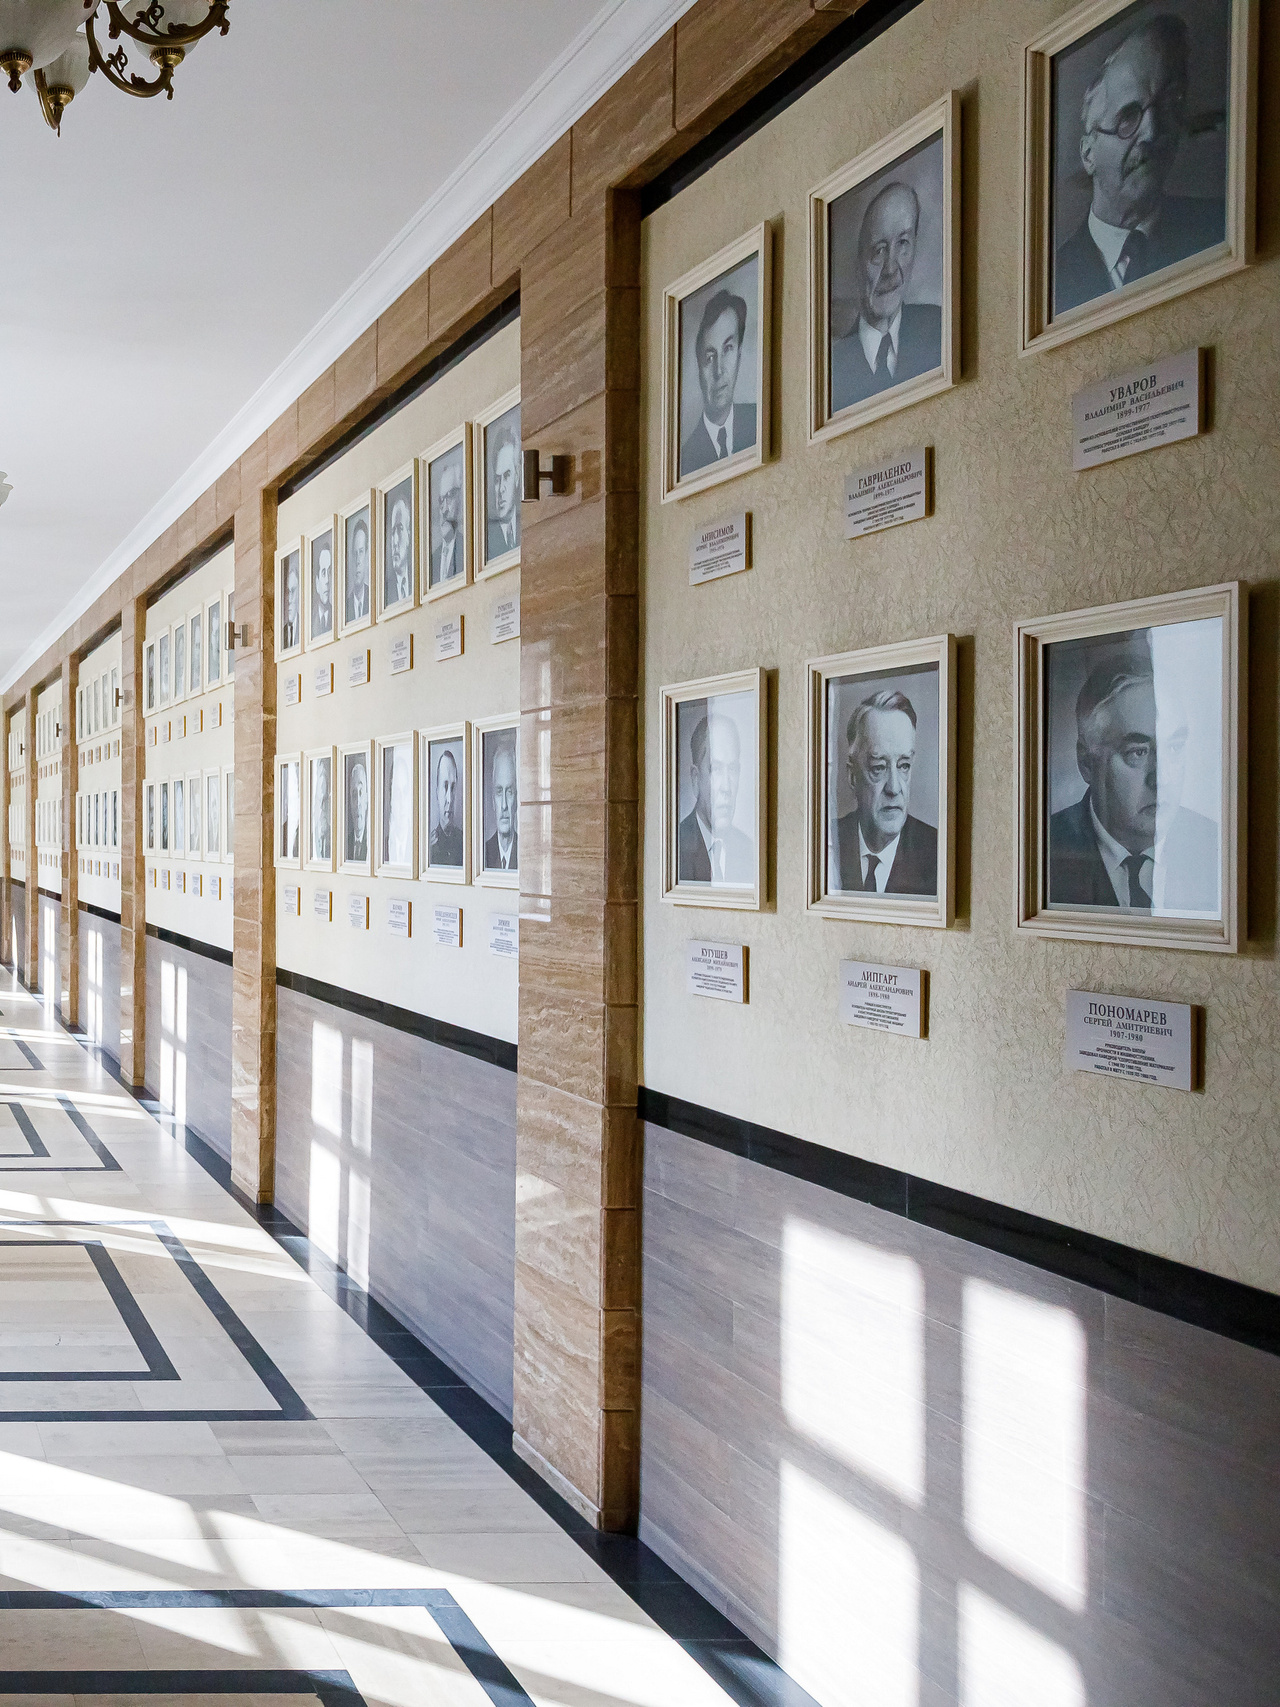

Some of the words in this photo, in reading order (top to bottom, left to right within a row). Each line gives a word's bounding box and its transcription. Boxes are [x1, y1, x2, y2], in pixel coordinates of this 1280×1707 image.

[1109, 375, 1157, 402] УВАРОВ
[1084, 400, 1126, 421] ВЛАДИМИР
[1130, 380, 1184, 406] ВАСИЛЬЕВИЧ
[1116, 402, 1151, 420] 1899-1977
[858, 462, 911, 489] ГАВРИЛЕНКО
[861, 971, 898, 985] ЛИПГАРТ
[869, 984, 913, 996] АЛЕКСАНДРОВИЧ
[1088, 1002, 1167, 1026] ПОНОМАРЕВ
[1083, 1016, 1112, 1028] СЕРГЕЙ
[1115, 1021, 1173, 1037] ДМИТРИЕВИЧ
[1109, 1030, 1143, 1042] 1907-1980
